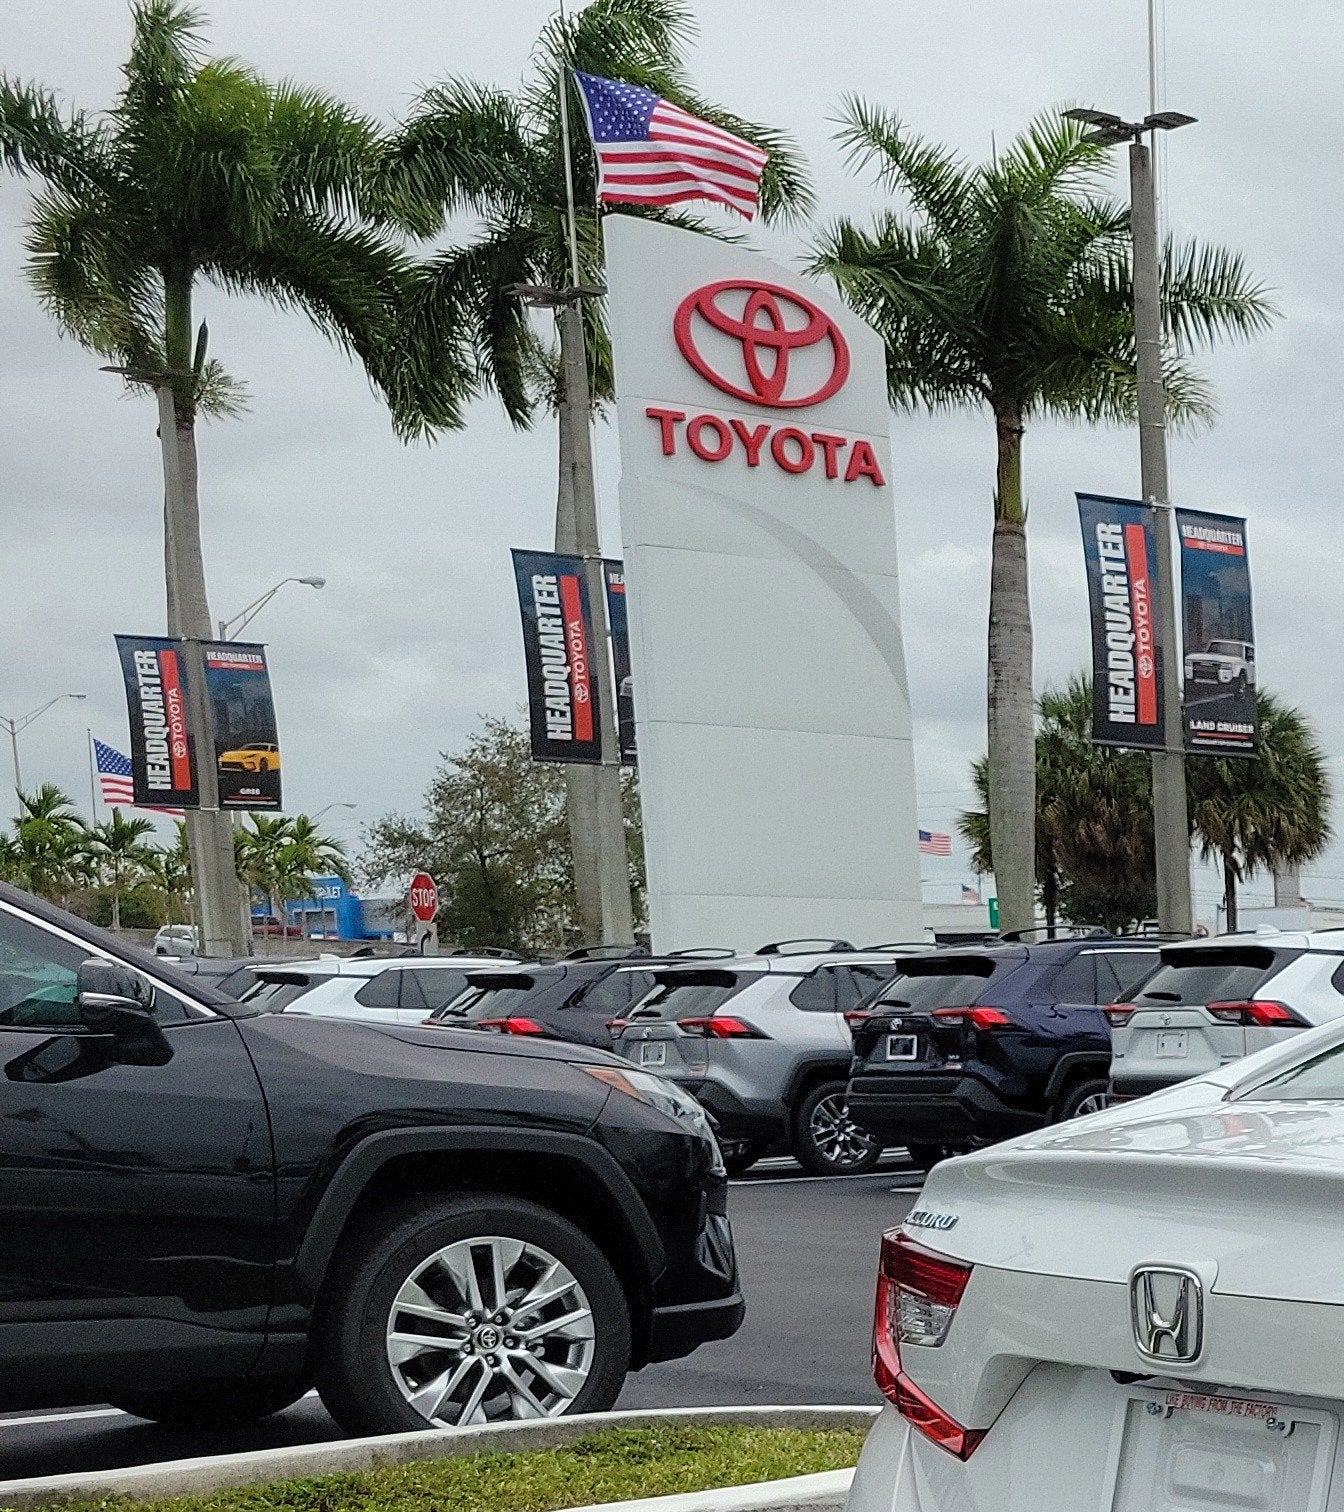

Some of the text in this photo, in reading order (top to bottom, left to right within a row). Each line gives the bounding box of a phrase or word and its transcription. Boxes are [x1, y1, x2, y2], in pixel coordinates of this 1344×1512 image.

[645, 407, 886, 487] TOYOTA
[569, 620, 587, 681] TOYOTA
[1095, 522, 1136, 724] HEADQUARTER
[1133, 578, 1153, 654] TOYOTA
[531, 573, 573, 741] HEADQUARTER
[133, 650, 172, 790] HEADQUARTER
[168, 687, 187, 739] TOYOTA
[1190, 718, 1255, 734] LAND CRUISER
[411, 888, 435, 907] STOP
